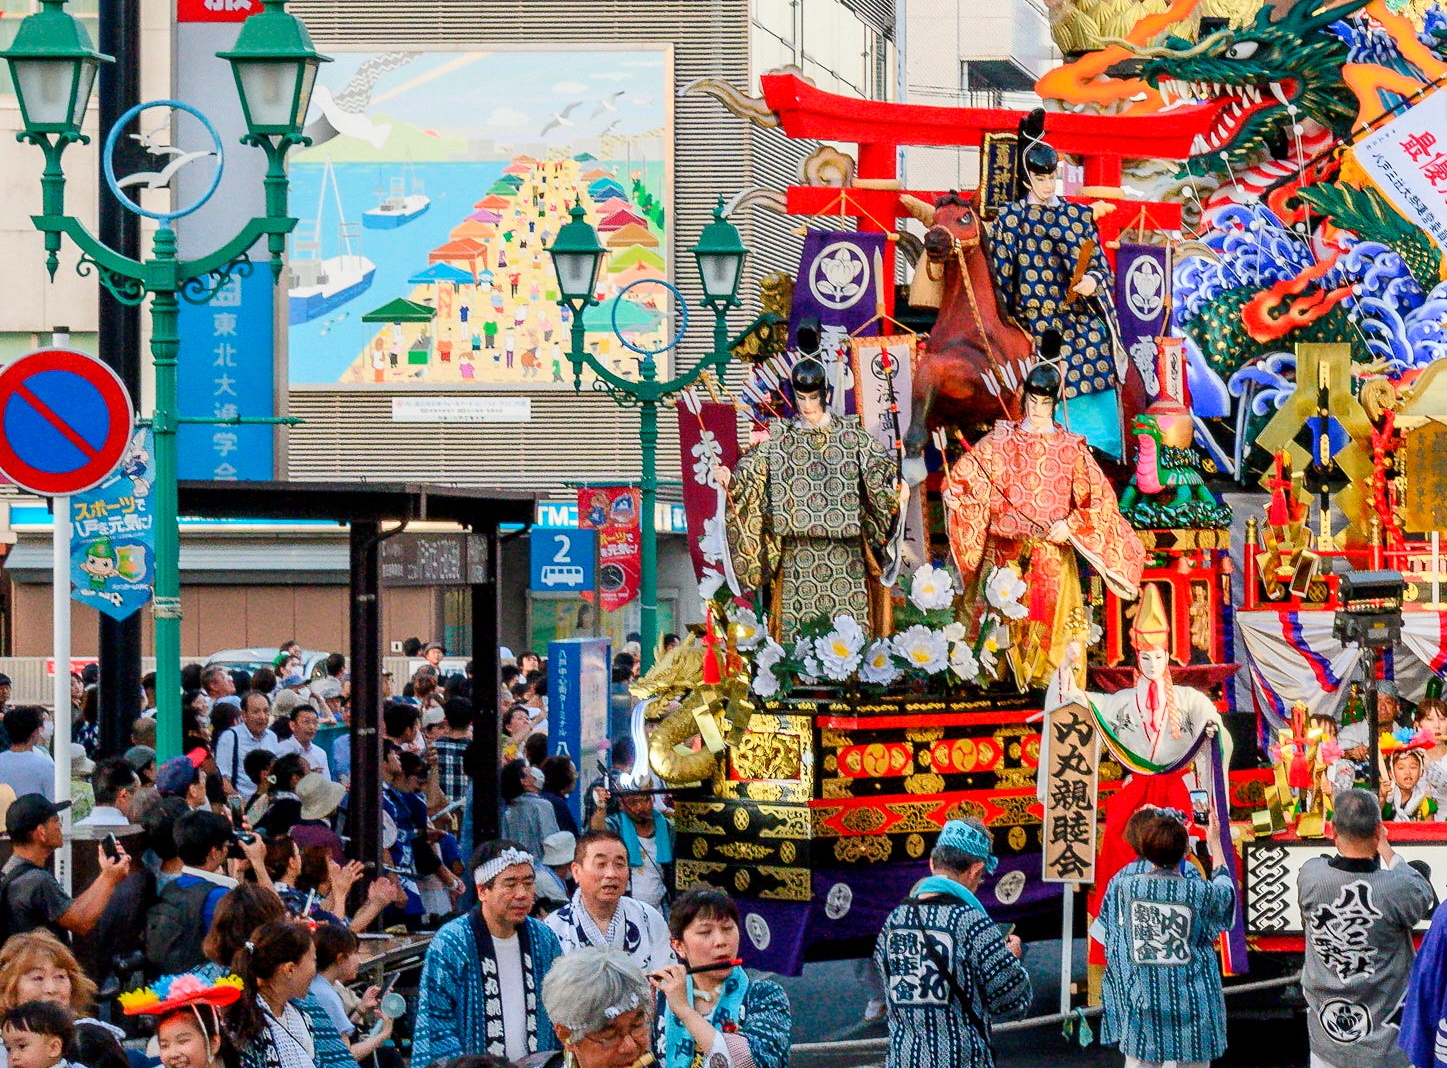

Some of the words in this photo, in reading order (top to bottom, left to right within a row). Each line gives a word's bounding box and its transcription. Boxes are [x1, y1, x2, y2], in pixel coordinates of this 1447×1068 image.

[212, 312, 239, 481] 東北大進学会
[73, 495, 147, 521] スポーツで
[552, 534, 572, 563] 2
[1048, 711, 1094, 879] 内丸親睦会
